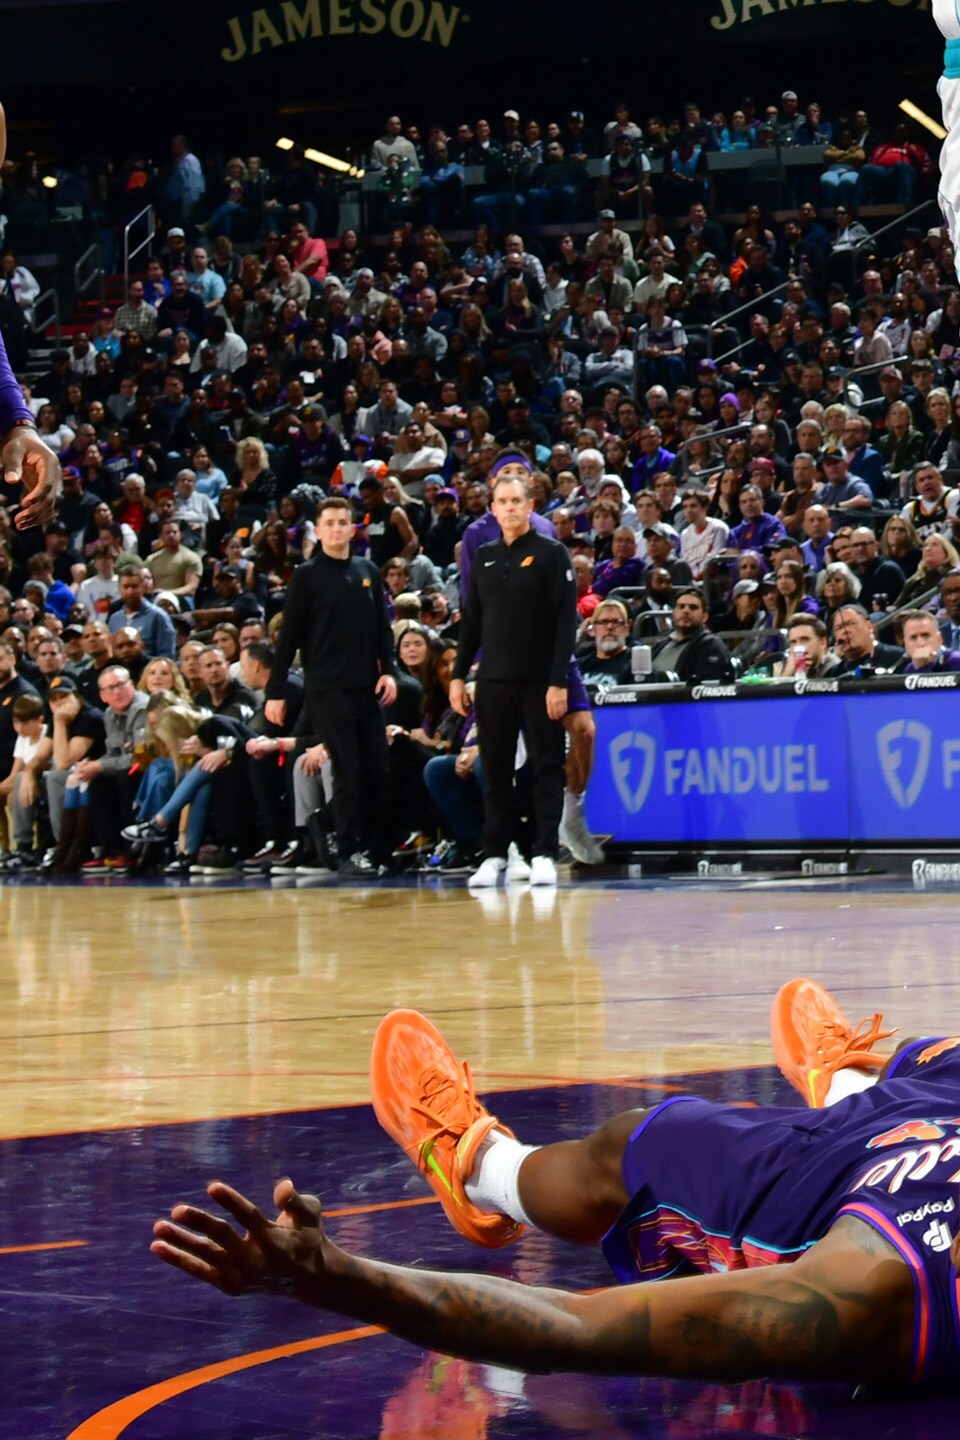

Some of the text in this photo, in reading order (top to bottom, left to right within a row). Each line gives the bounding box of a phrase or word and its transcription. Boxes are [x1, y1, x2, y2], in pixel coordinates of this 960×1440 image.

[702, 685, 737, 697] FANDUEL
[917, 675, 957, 688] FANDUEL
[664, 744, 830, 796] FANDUEL
[896, 1196, 956, 1227] PayPal
